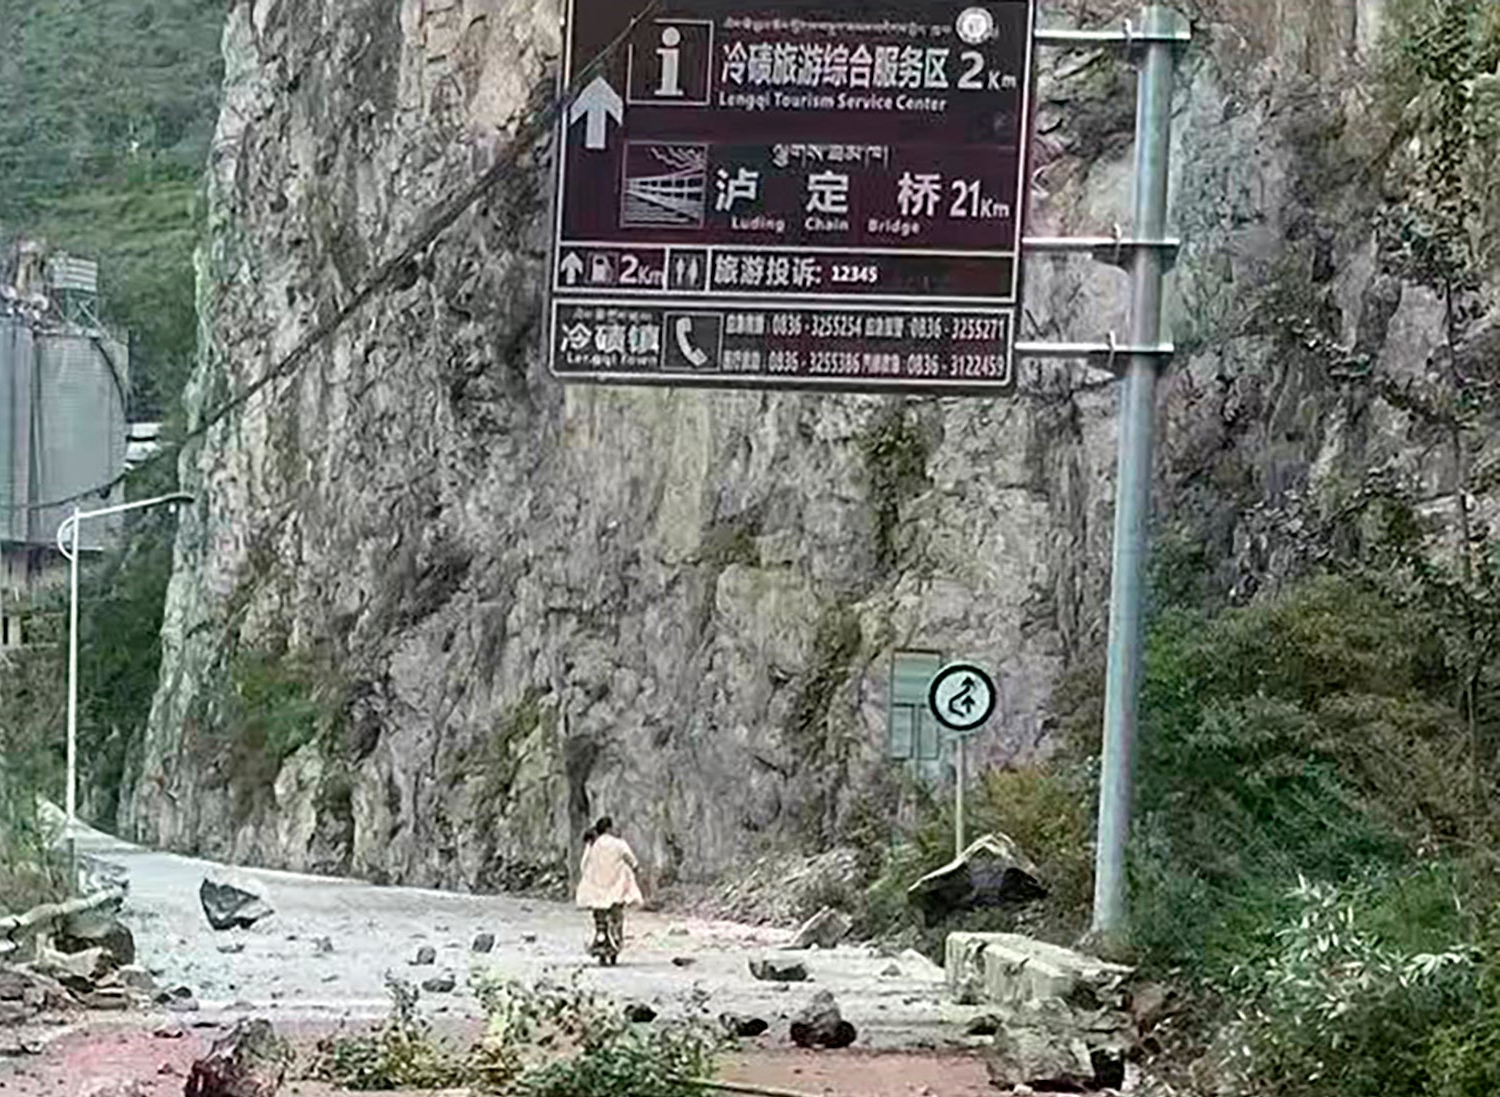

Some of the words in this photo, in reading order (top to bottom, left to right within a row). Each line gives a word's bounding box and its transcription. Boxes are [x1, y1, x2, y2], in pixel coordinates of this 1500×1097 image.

[721, 41, 950, 88] 冷碛旅游综合服务区
[774, 92, 835, 109] Tourism
[837, 92, 893, 110] Service
[896, 94, 947, 111] Center
[731, 216, 786, 233] Luding
[804, 216, 849, 232] Chain
[867, 218, 921, 236] Bridge
[831, 265, 878, 283] 12345
